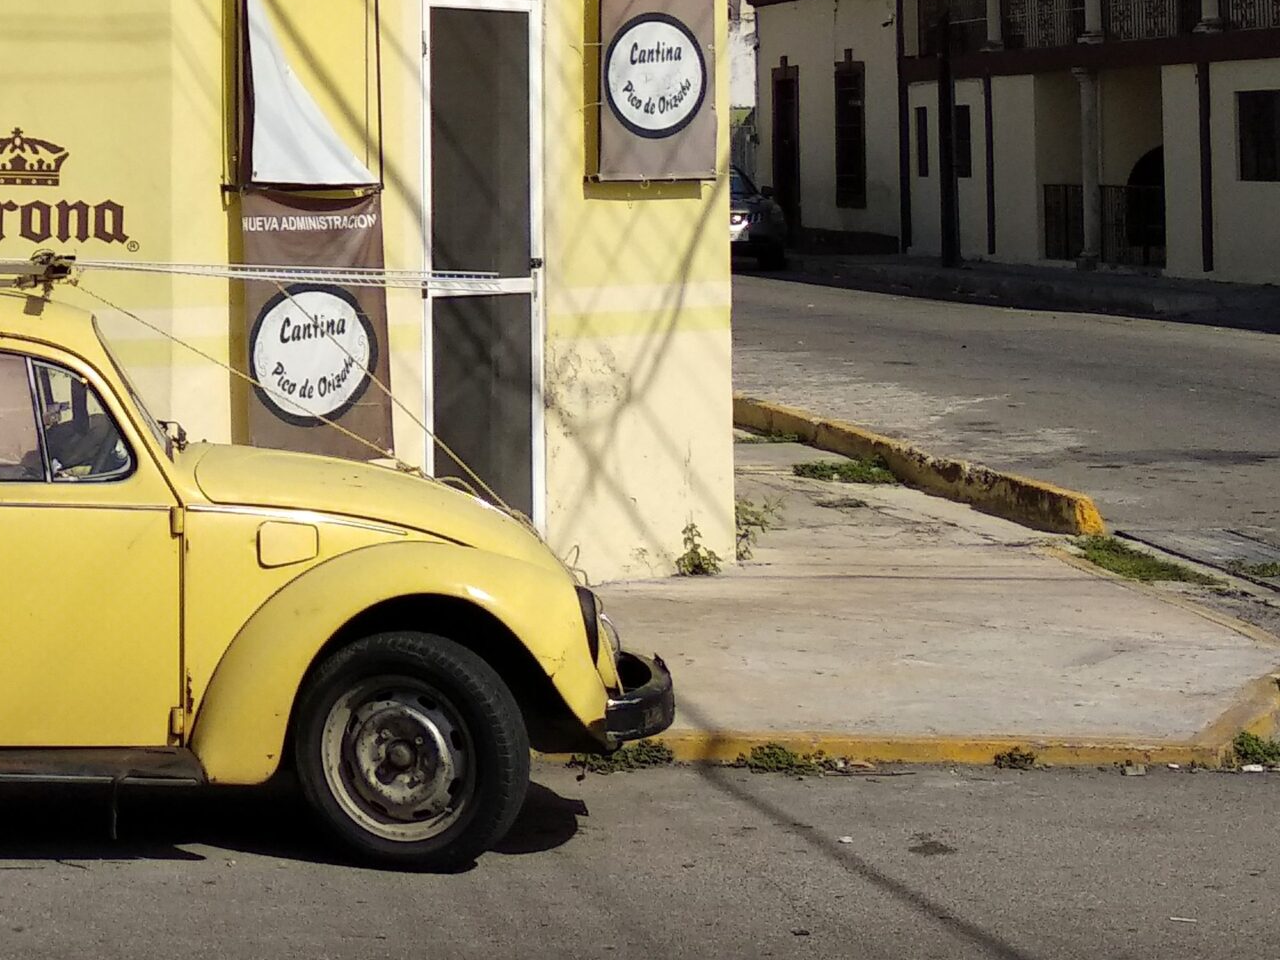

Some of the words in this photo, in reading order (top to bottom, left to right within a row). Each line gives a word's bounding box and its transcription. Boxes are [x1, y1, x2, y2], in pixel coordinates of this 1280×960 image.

[630, 41, 682, 65] Cantina
[622, 80, 642, 110] Pico
[643, 97, 656, 115] de
[658, 78, 691, 114] Orizaba
[281, 214, 377, 231] ADMINISTRACION
[280, 314, 346, 343] Cantina
[272, 361, 297, 395] Pico
[299, 378, 314, 399] de
[318, 356, 354, 397] Orizaba
